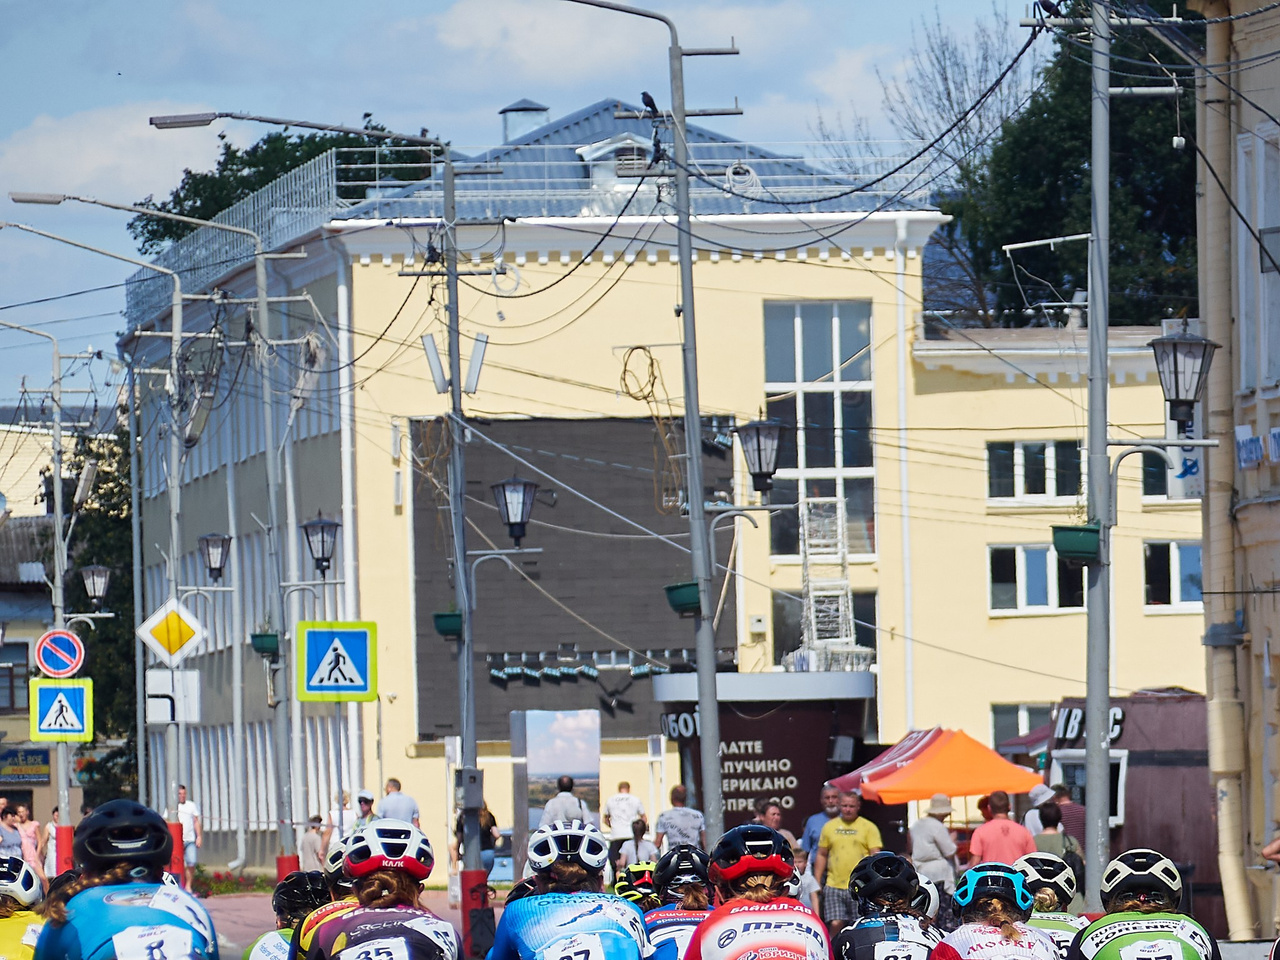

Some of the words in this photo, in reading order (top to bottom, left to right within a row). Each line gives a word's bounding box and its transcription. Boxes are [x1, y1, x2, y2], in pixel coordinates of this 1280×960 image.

[1053, 706, 1124, 739] КВС
[720, 758, 792, 774] ПУЧИНО
[722, 776, 798, 792] ЕРИКАНО
[966, 939, 1036, 955] МОСКВ
